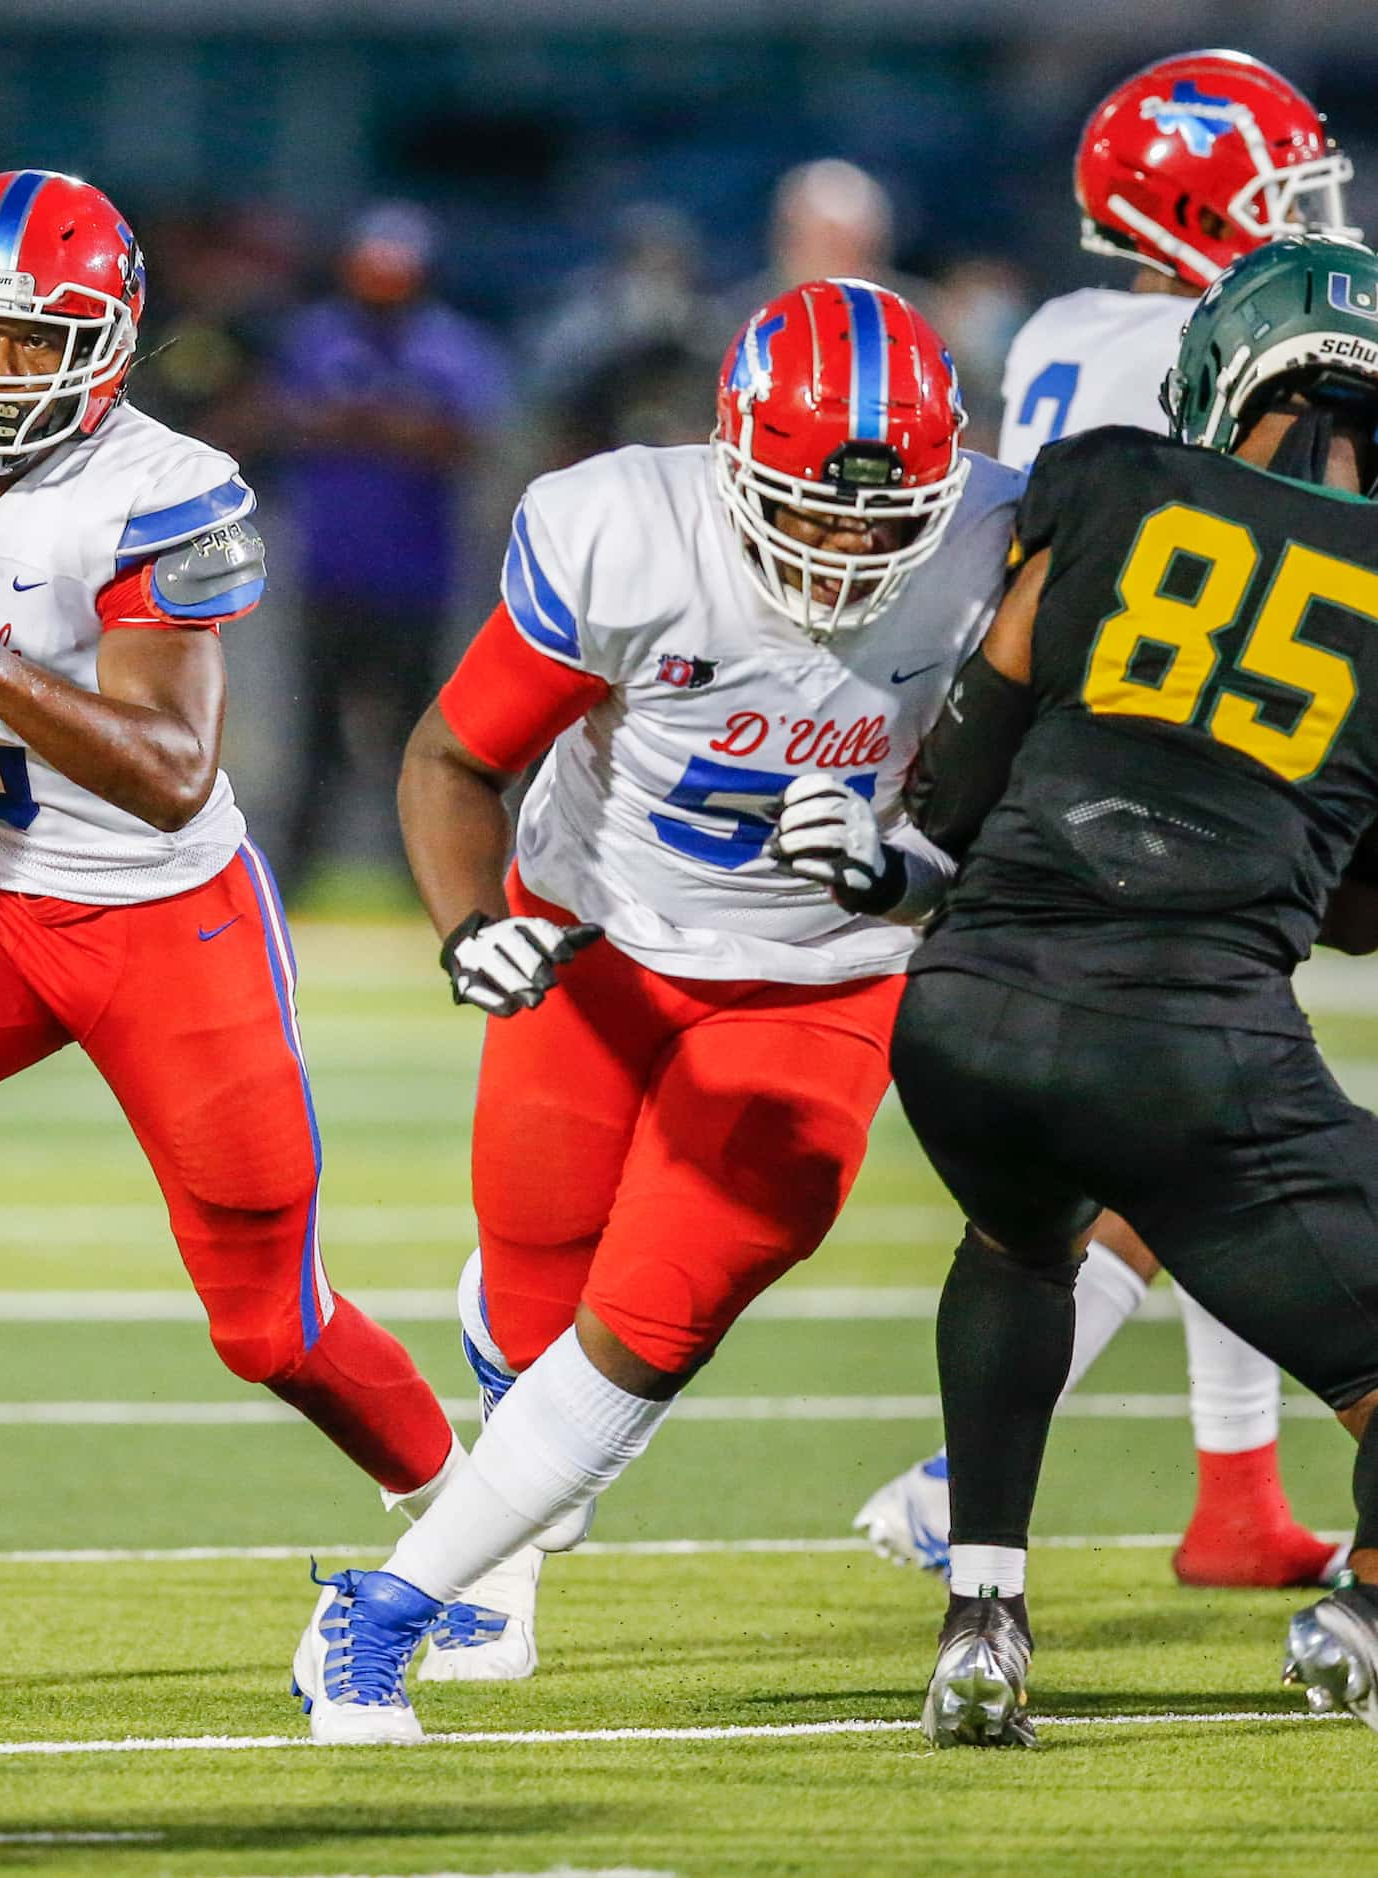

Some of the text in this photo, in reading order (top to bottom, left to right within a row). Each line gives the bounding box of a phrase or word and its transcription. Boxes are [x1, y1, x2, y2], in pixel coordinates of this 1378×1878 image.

[1081, 501, 1378, 784] 85
[710, 711, 891, 769] D'Ville
[648, 754, 879, 871] 5
